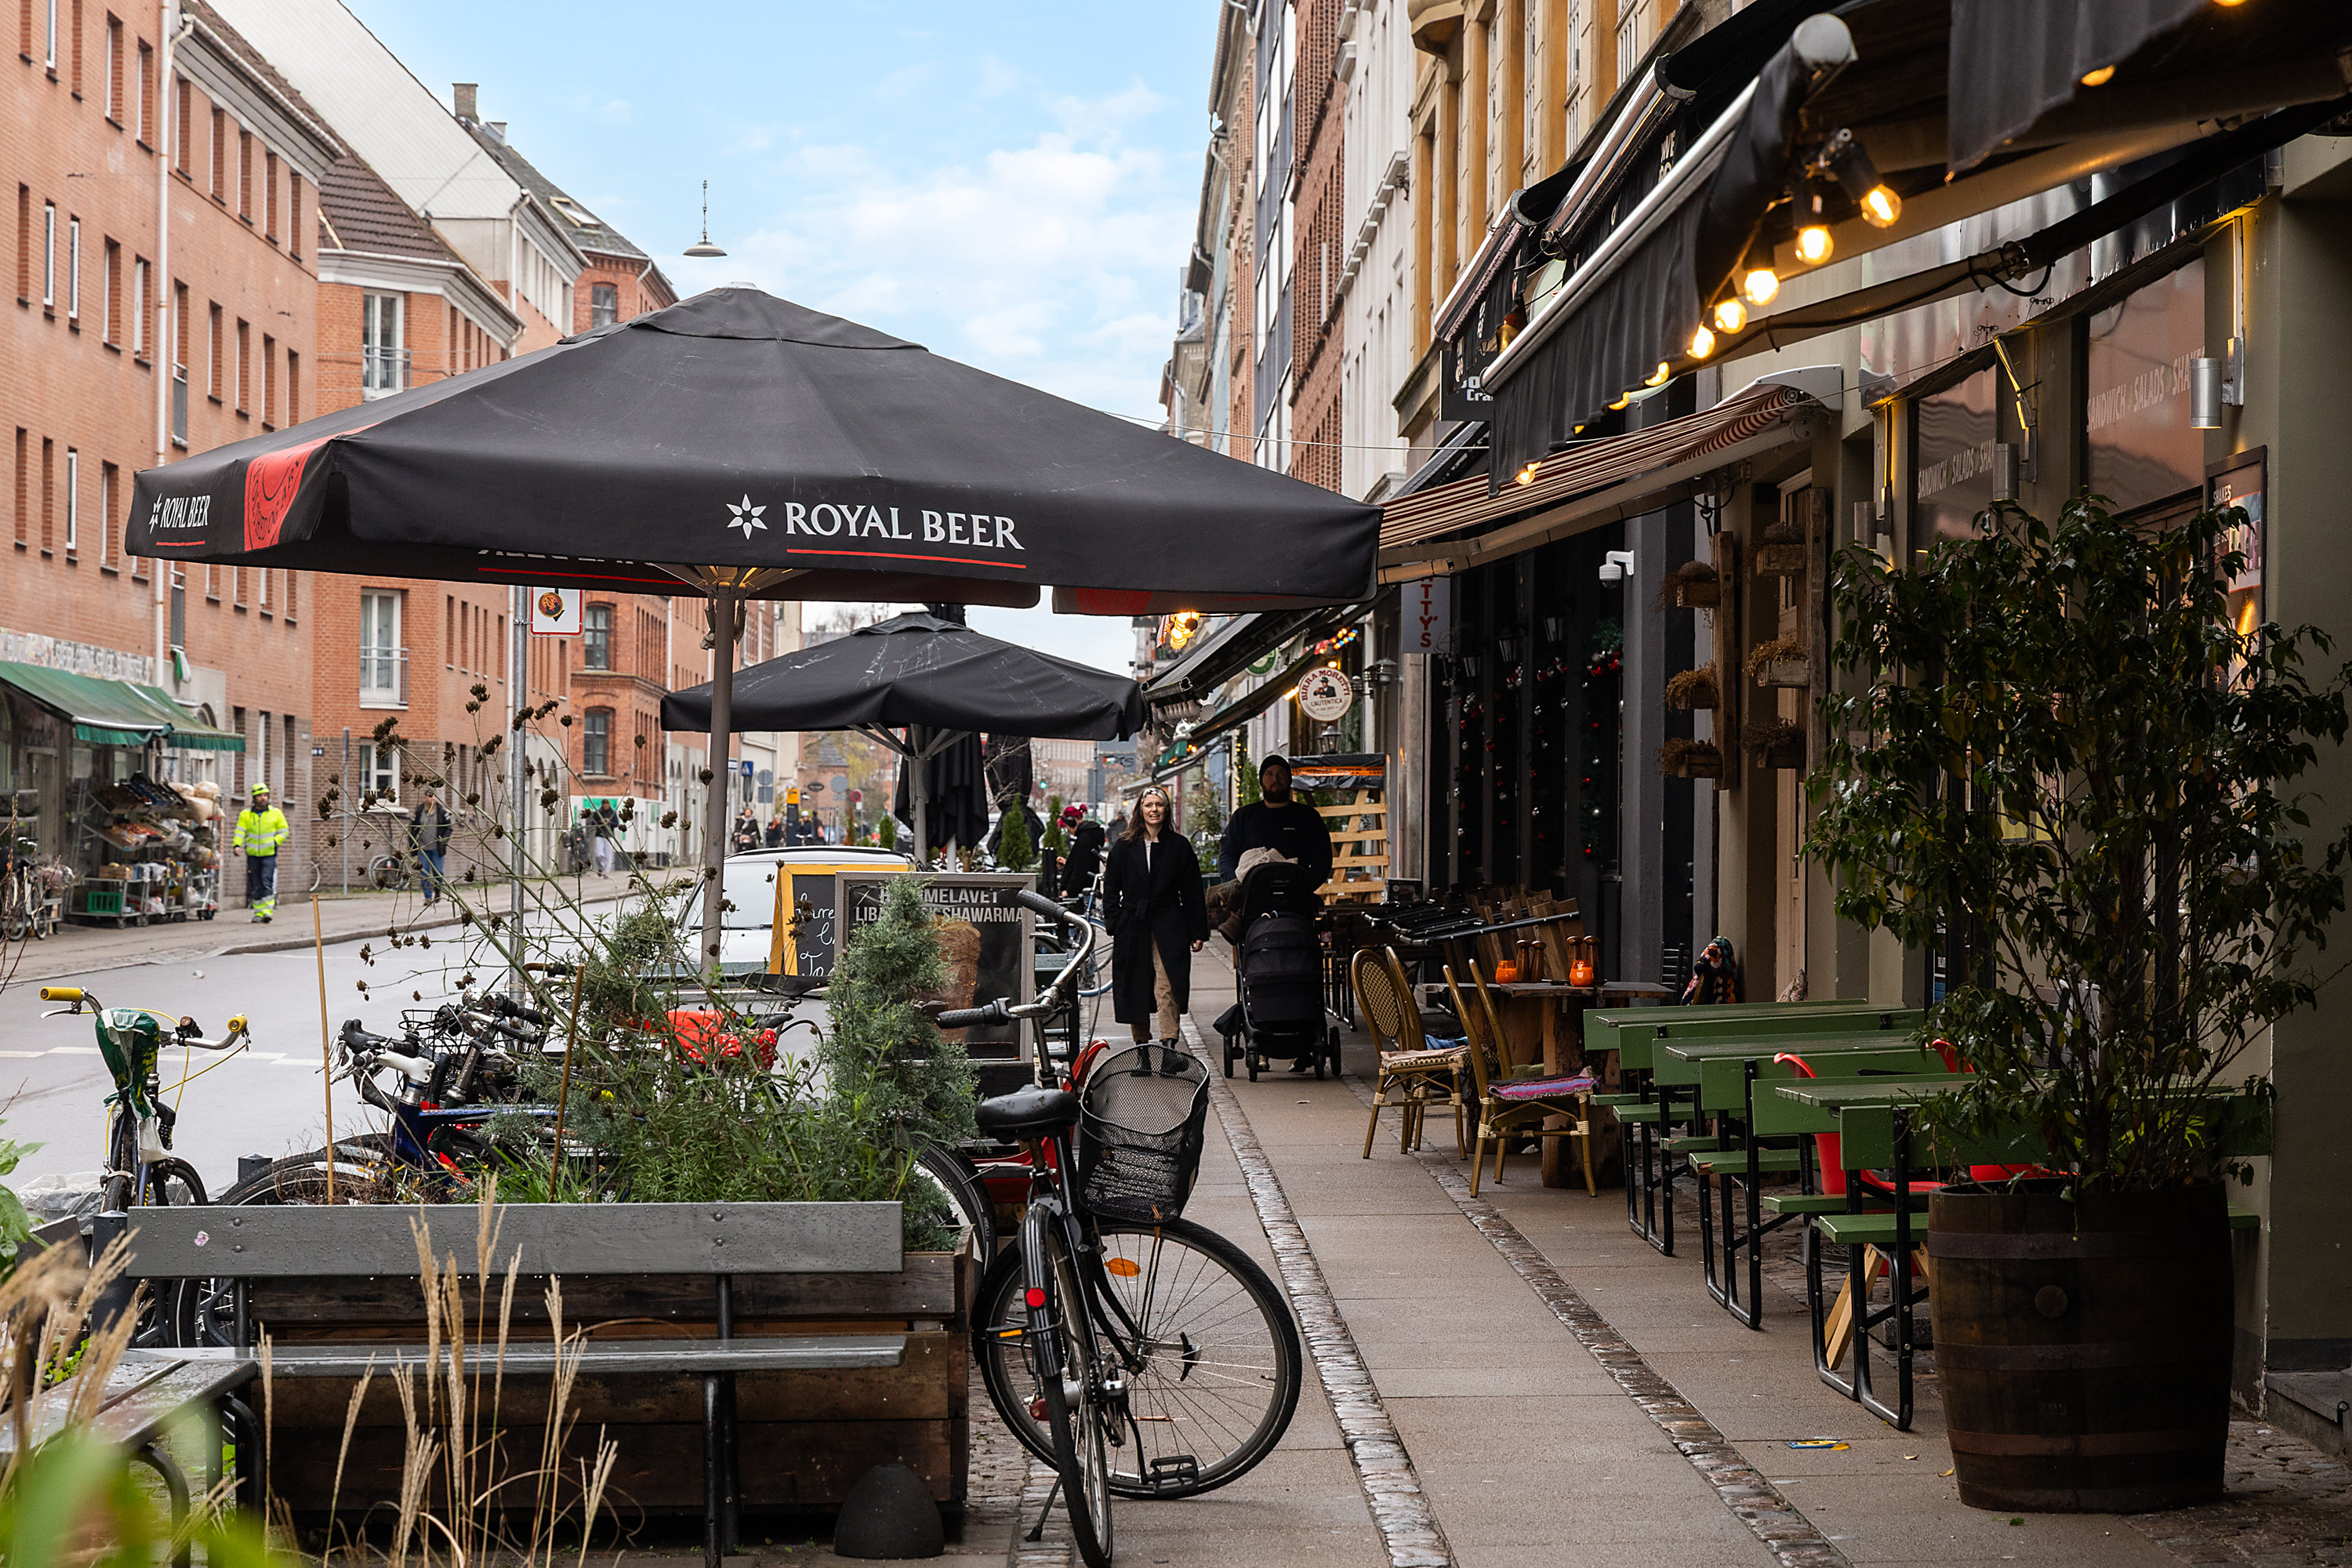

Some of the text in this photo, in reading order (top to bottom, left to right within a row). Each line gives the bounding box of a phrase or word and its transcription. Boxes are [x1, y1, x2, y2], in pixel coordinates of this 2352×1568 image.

[1466, 389, 1494, 401] Cra
[2086, 346, 2205, 434] SANDWICH SALADS SHA
[1918, 459, 1947, 500] SANDWICH
[1951, 447, 1974, 485] SALADS
[159, 495, 211, 529] ROYAL BEER
[784, 502, 1025, 550] ROYAL BEER
[1419, 577, 1439, 648] TTY'S
[1301, 670, 1350, 701] BIRRA MORETTI
[880, 887, 999, 904] HMELAVET
[942, 907, 1023, 924] SHAWARMA
